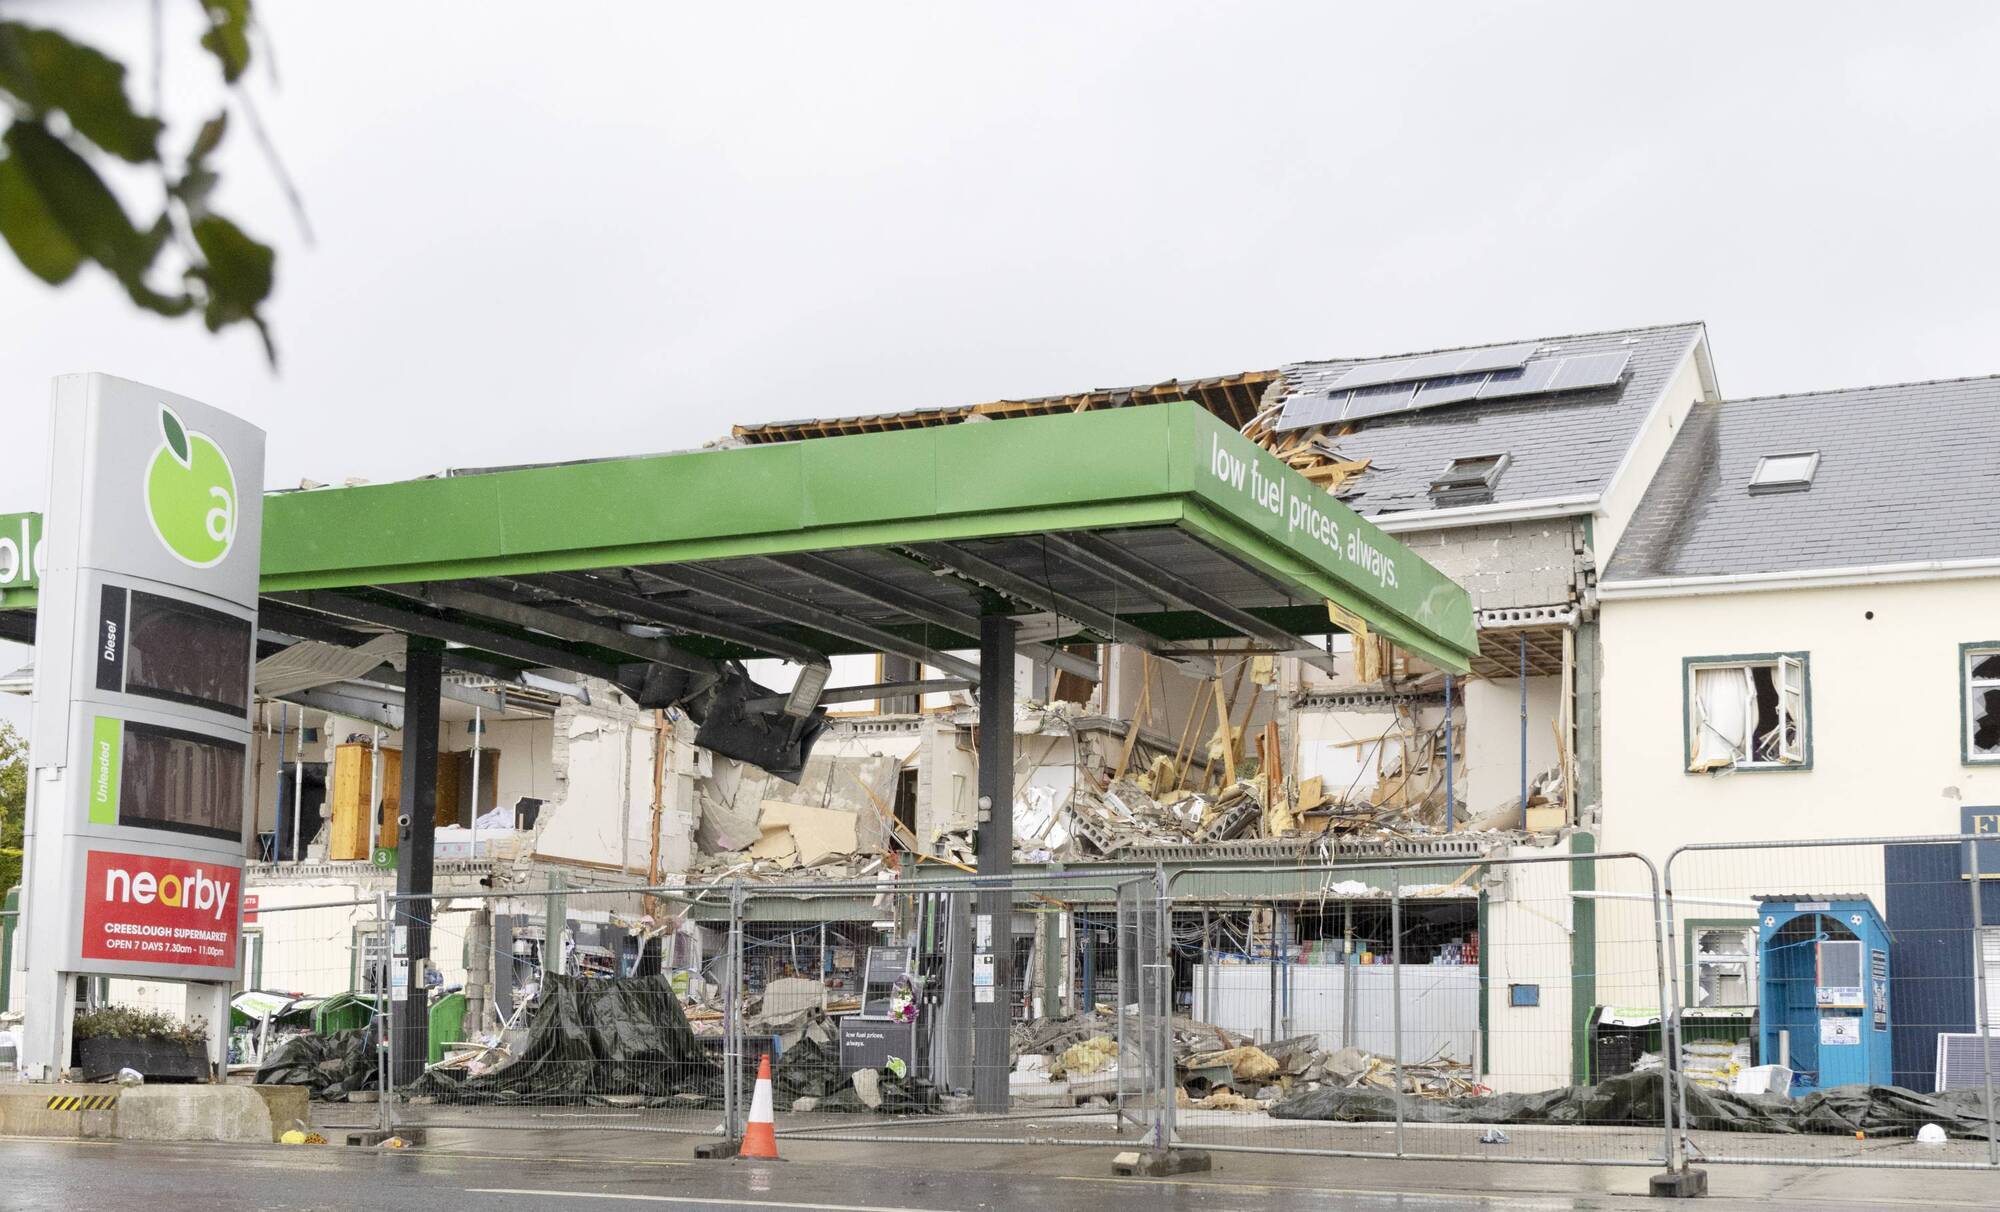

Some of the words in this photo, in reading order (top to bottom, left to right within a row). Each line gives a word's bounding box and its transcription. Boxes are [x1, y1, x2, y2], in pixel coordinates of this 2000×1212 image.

[206, 486, 232, 542] a
[1211, 431, 1246, 492] low
[1250, 458, 1286, 518] fuel
[1288, 494, 1343, 561] prices,
[1347, 527, 1399, 589] always.
[103, 620, 117, 662] Diesel
[97, 741, 111, 803] Unleaded
[377, 851, 387, 863] 3
[105, 868, 231, 920] nearby
[104, 922, 172, 938] CREESLOUGH
[173, 928, 227, 943] SUPERMARKET
[106, 938, 133, 950] OPEN
[134, 940, 140, 950] 7
[141, 941, 164, 951] DAYS
[165, 942, 192, 954] 7.30am
[198, 944, 224, 957] 11.00pm
